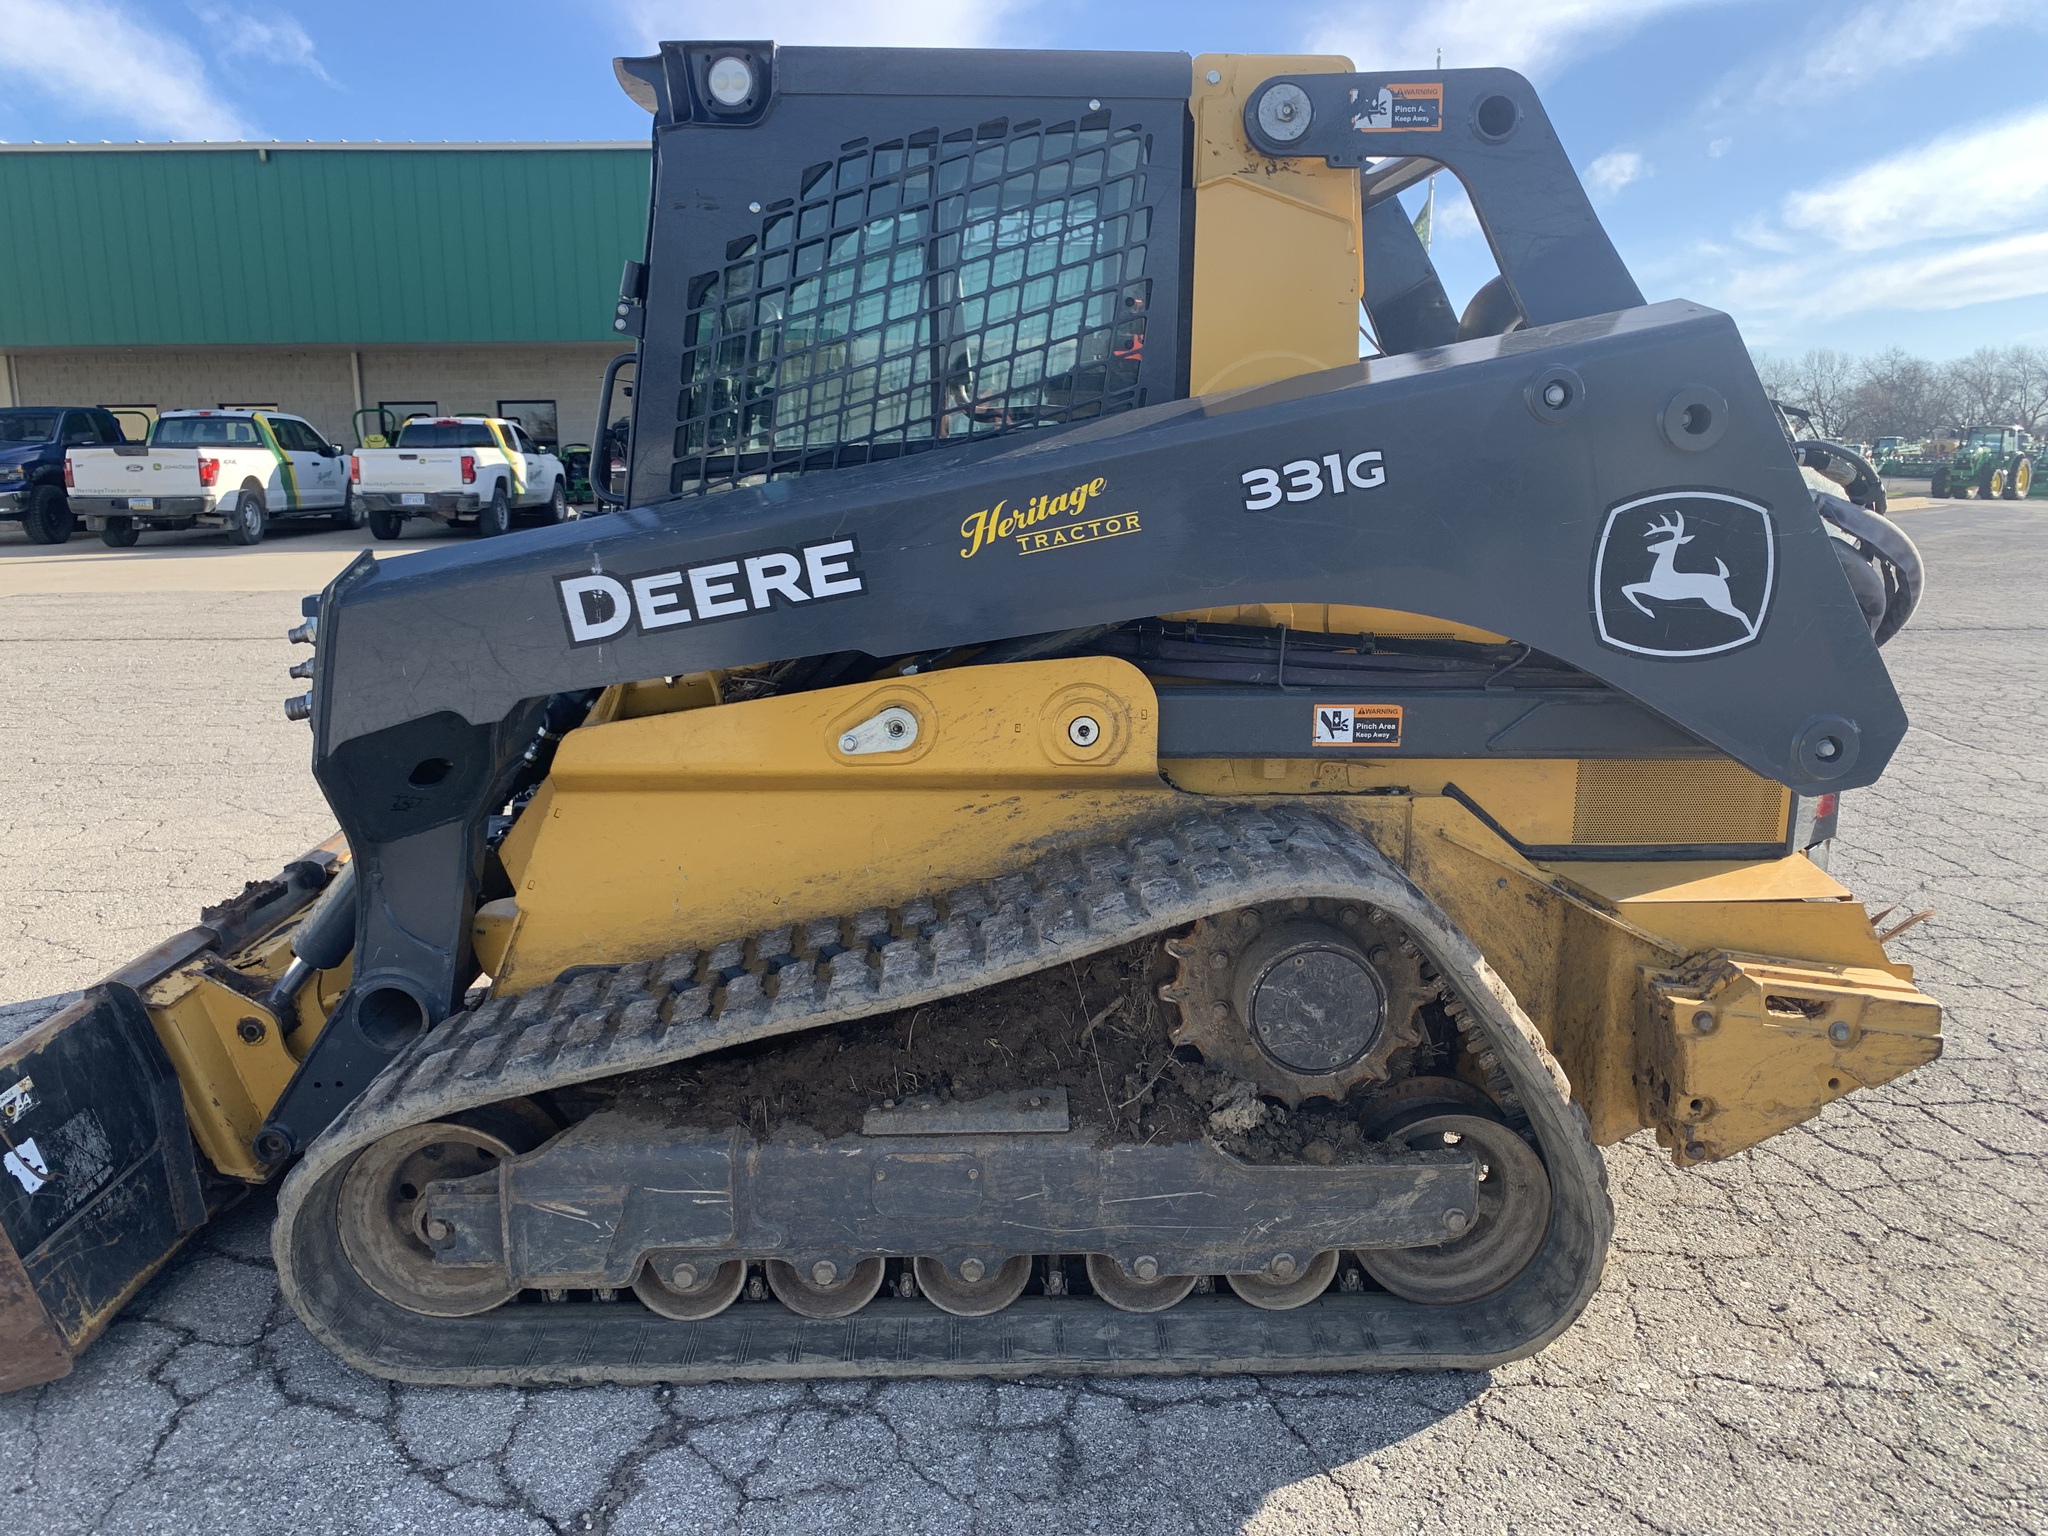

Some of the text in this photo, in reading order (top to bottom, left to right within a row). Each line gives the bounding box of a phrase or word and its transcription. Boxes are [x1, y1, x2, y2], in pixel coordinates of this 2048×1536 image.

[1404, 88, 1438, 96] WARNING
[1394, 105, 1417, 113] Pinch
[1394, 115, 1429, 123] Keep Away
[1242, 451, 1386, 511] 331G
[960, 477, 1108, 559] Heritage
[1017, 514, 1142, 552] TRACTOR
[560, 540, 863, 642] DEERE
[1356, 722, 1396, 730] Pinch Area
[1372, 731, 1390, 739] Away
